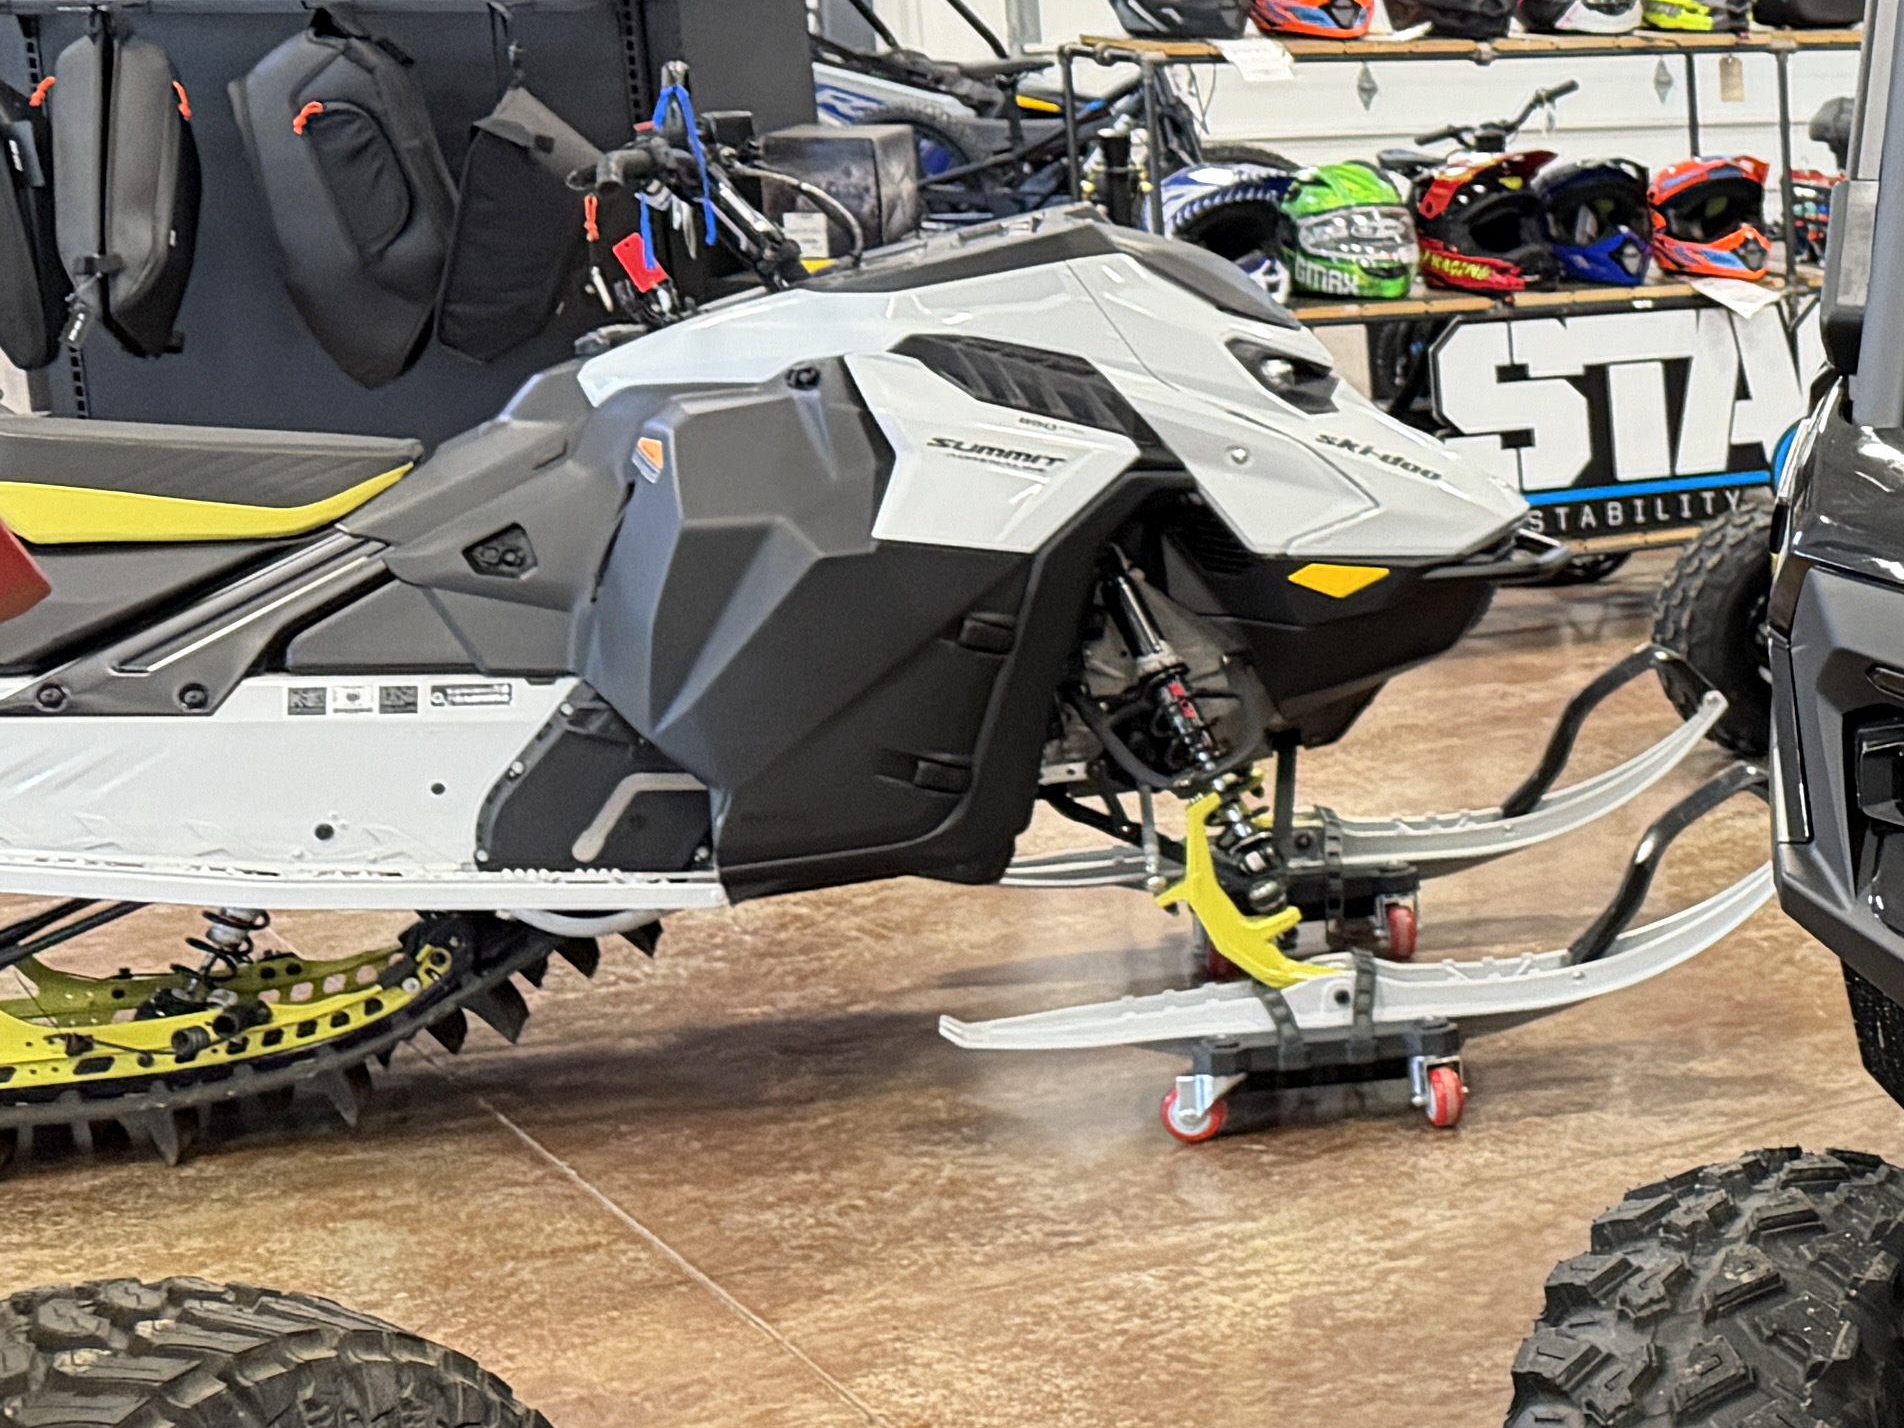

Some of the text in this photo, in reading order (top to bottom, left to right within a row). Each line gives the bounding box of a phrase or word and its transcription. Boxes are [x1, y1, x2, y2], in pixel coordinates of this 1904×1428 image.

[926, 437, 1067, 467] SUMMIT
[1315, 432, 1444, 482] ski-doo
[1527, 489, 1742, 535] STABILITY
